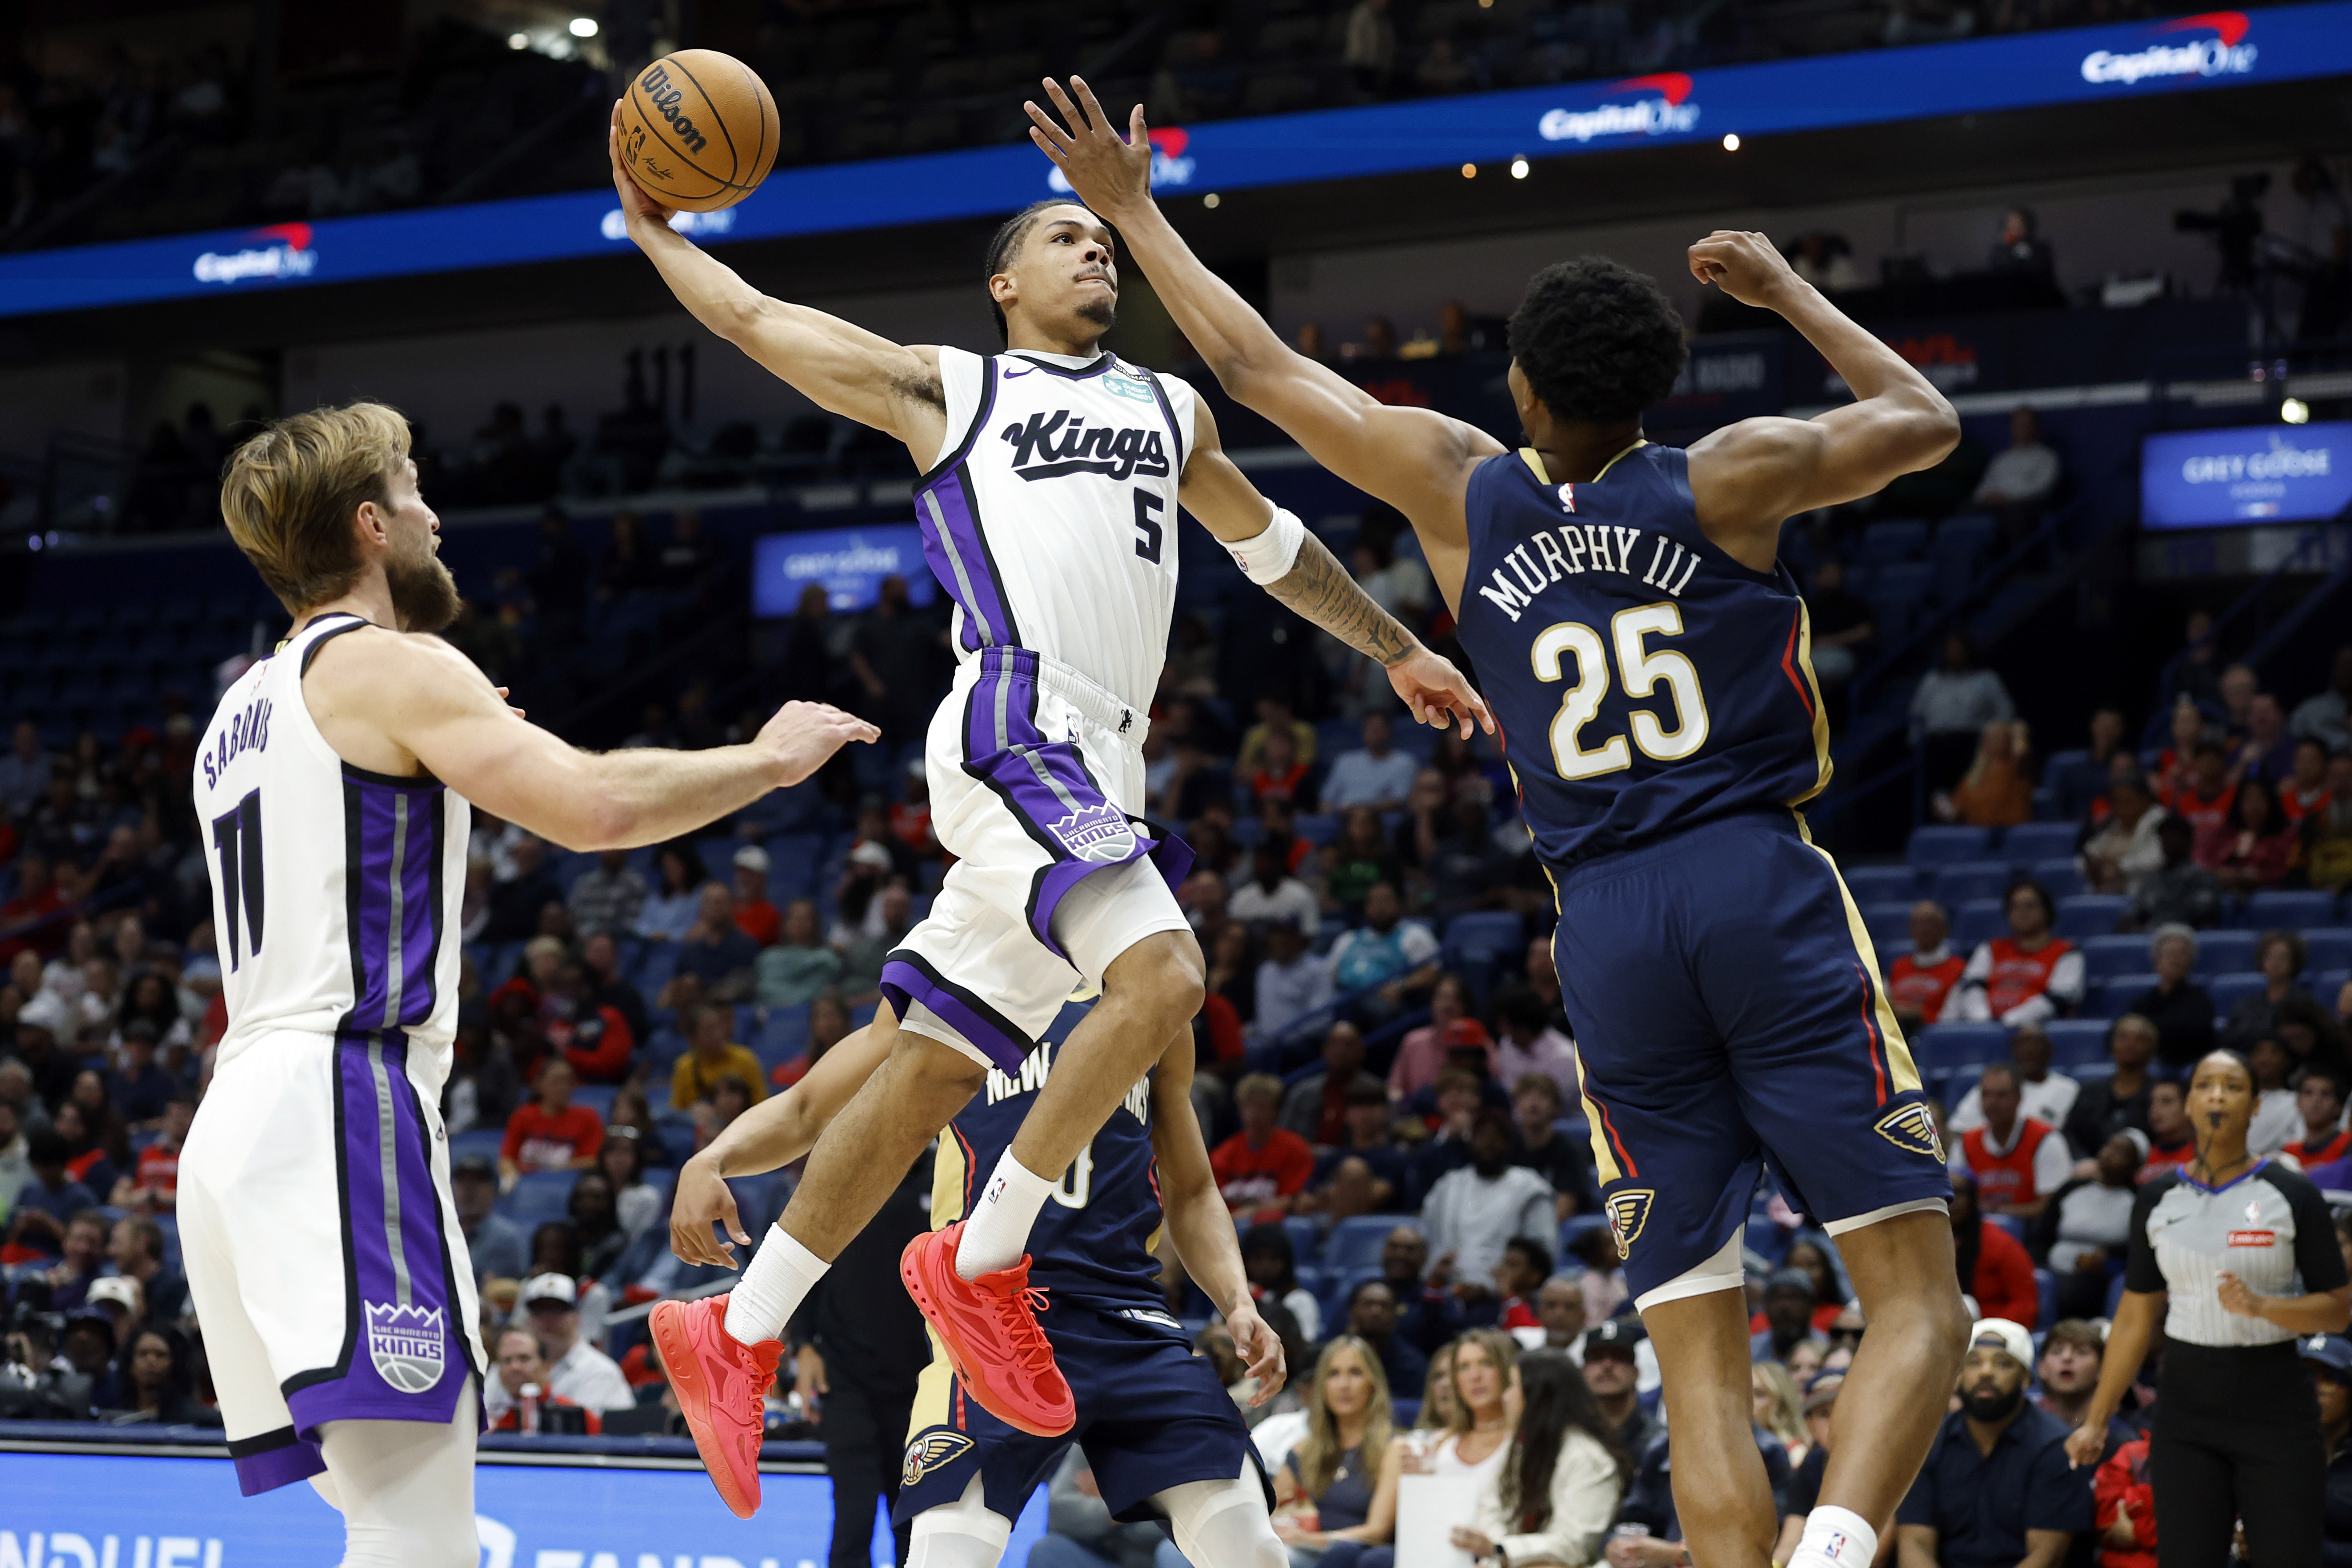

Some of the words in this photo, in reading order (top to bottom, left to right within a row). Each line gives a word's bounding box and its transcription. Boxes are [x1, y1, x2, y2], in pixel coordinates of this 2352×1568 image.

[640, 64, 707, 156] Wilson
[1113, 363, 1151, 382] ADELMAN
[1122, 382, 1147, 394] Sutter
[1125, 388, 1152, 400] Health
[1001, 410, 1169, 482] Kings
[1134, 487, 1163, 565] 5
[1479, 524, 1641, 622] MURPHY
[1642, 535, 1701, 597] III
[1531, 601, 1710, 780] 25
[203, 697, 272, 791] SABONIS
[1063, 815, 1118, 838] SACRAMENTO
[1067, 823, 1129, 850] KINGS
[212, 786, 264, 974] 11
[374, 1325, 440, 1341] SACRAMENTO
[374, 1337, 441, 1360] KINGS
